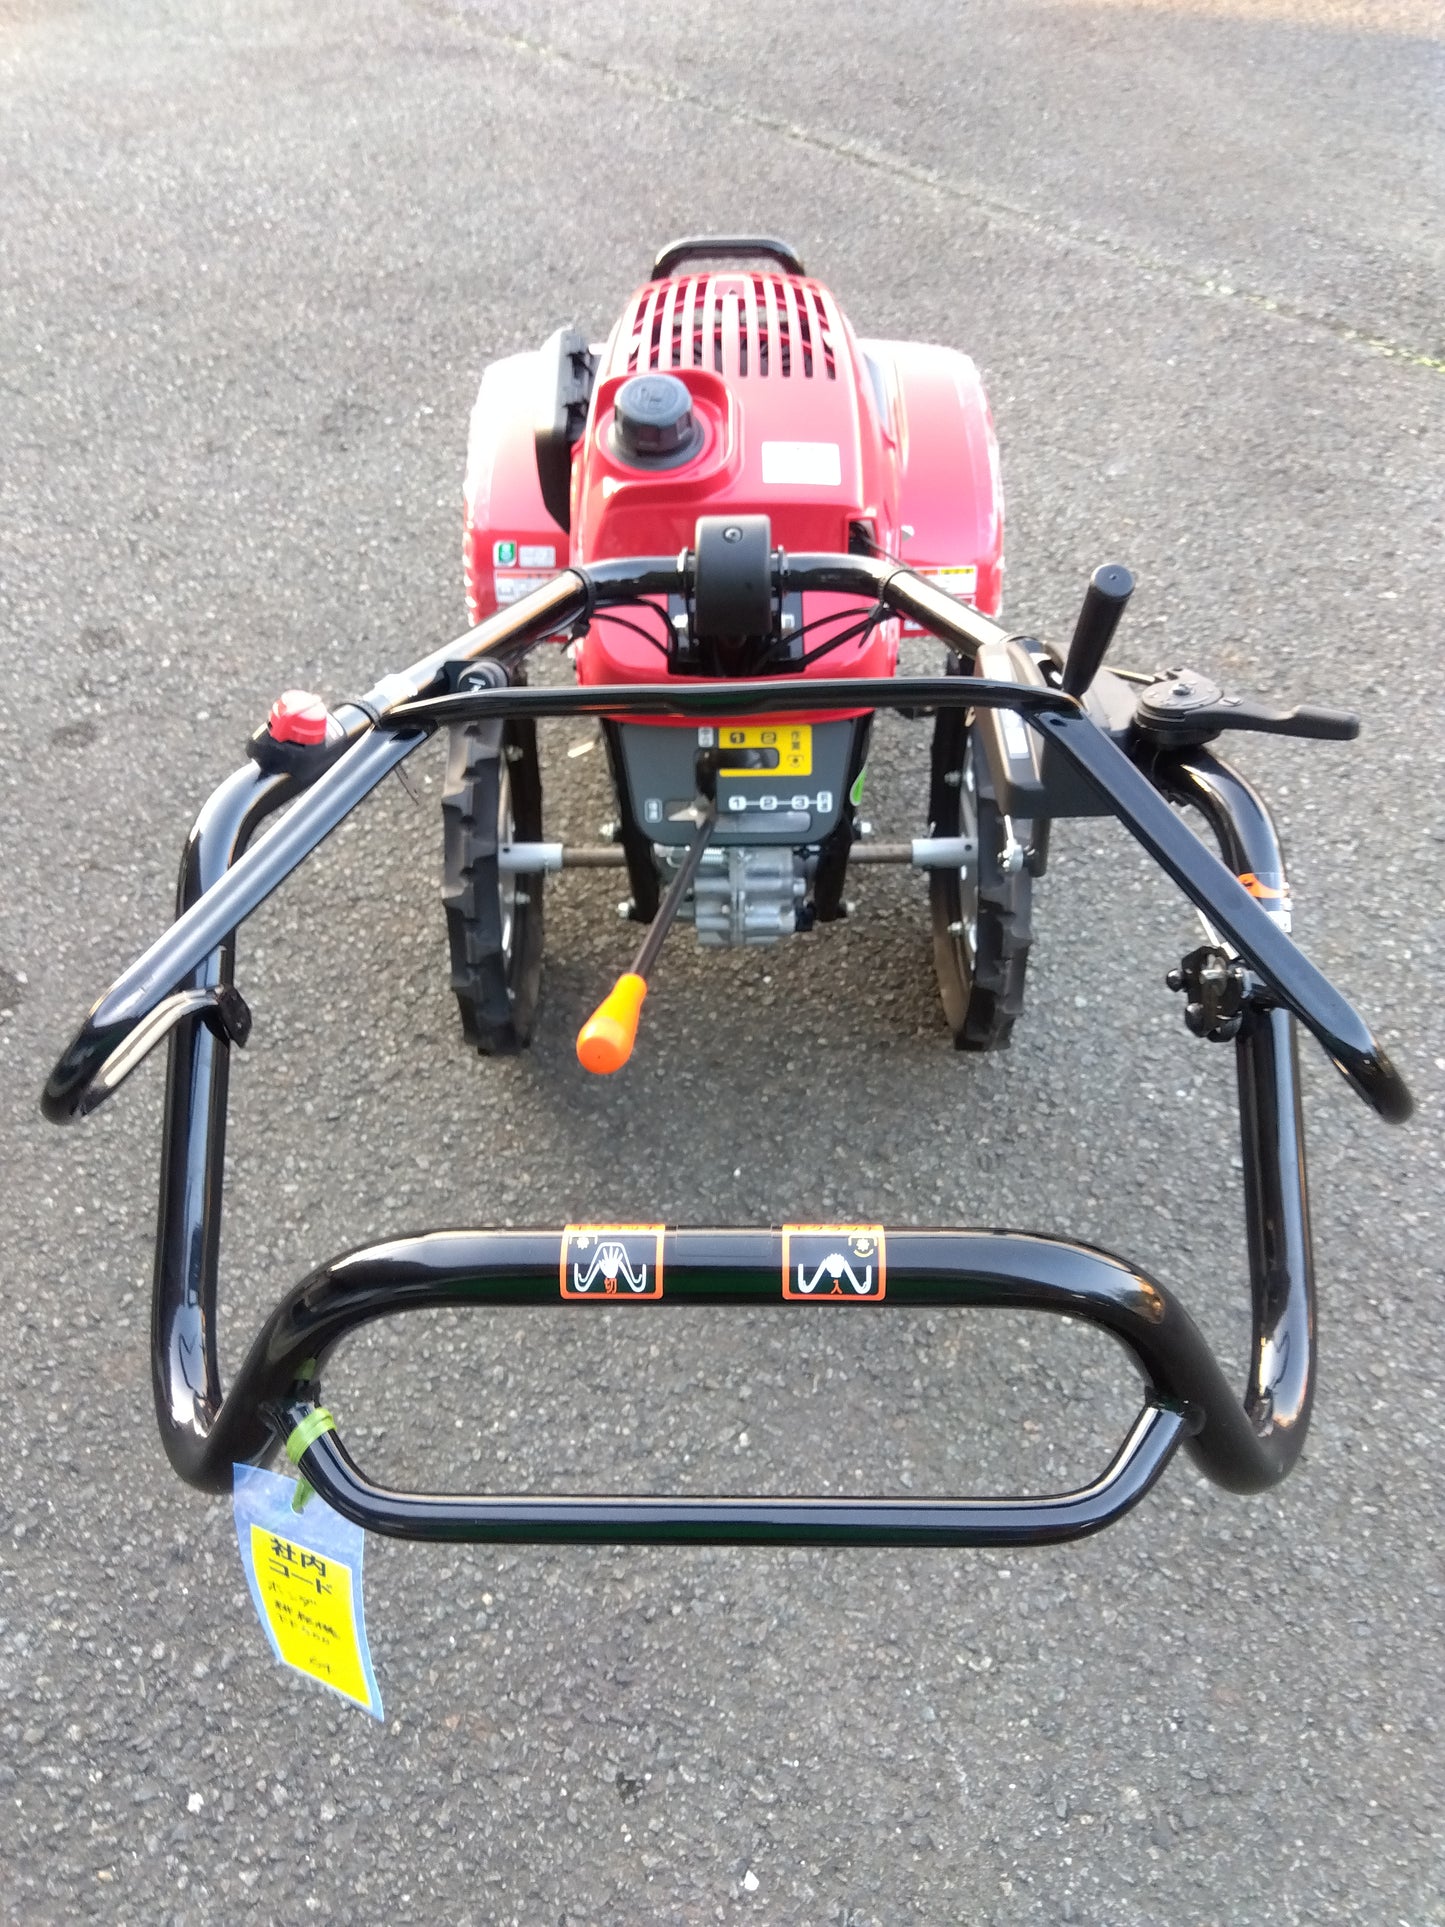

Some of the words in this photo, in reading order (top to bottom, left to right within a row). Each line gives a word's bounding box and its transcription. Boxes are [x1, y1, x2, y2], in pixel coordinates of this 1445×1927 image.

[604, 1277, 618, 1294] 切
[830, 1279, 843, 1295] 入
[270, 1537, 326, 1577] 社内
[268, 1558, 333, 1595] コード
